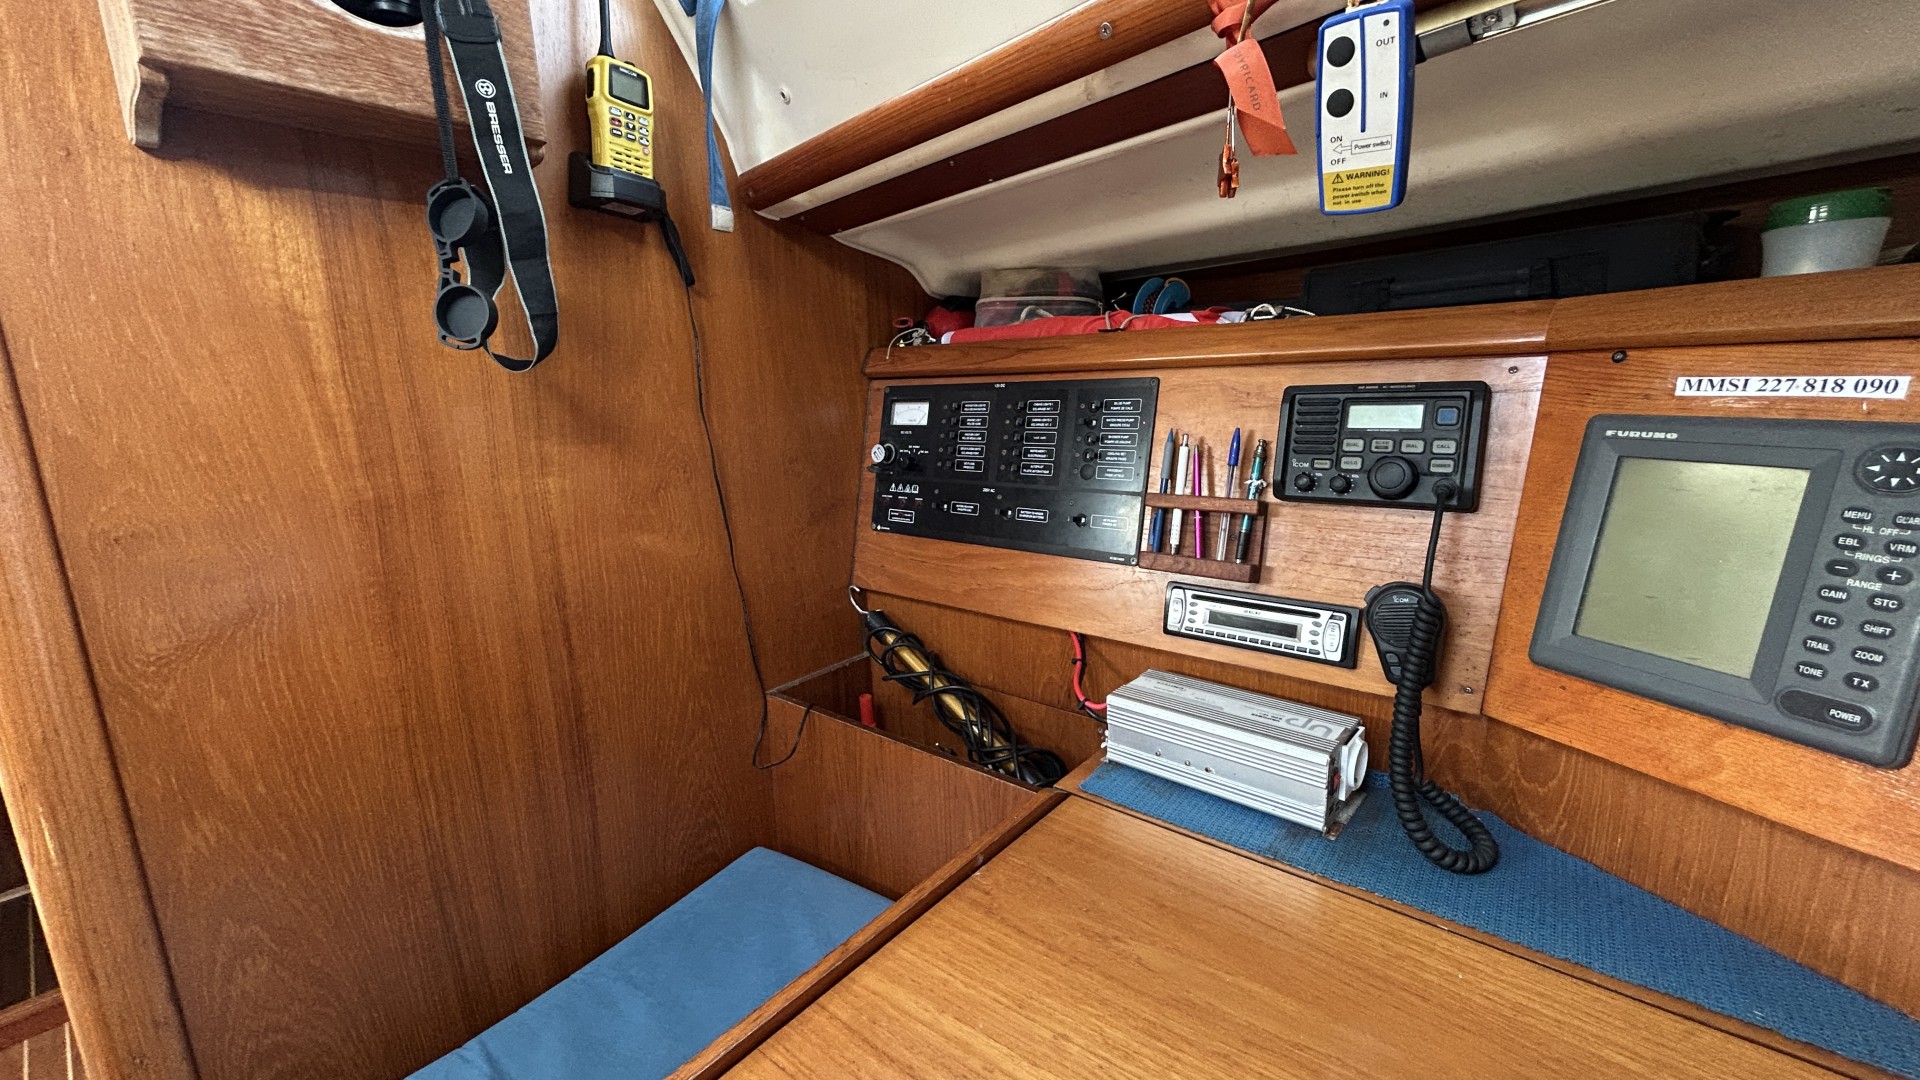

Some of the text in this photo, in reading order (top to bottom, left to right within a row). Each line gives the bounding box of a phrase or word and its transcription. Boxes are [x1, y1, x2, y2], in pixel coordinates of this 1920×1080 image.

[1376, 36, 1396, 47] OUT
[486, 102, 512, 174] BRESSER
[1330, 158, 1346, 166] OFF
[1346, 169, 1390, 180] WARNING!
[1681, 378, 1899, 394] MMSI 227 818 090
[1605, 429, 1678, 440] FURUNO
[1844, 510, 1872, 520] MENU
[1862, 526, 1900, 536] HL OFF
[1838, 537, 1860, 546] EBL
[1890, 543, 1917, 554] VRM
[1855, 552, 1890, 564] RINGS
[1846, 579, 1882, 591] RANGE
[1821, 589, 1848, 600] GAIN
[1874, 598, 1898, 609] STC
[1815, 615, 1836, 626] FTC
[1863, 624, 1892, 636] SHIFT
[1806, 640, 1830, 651] TRAIL
[1855, 651, 1883, 662] ZOOM
[1799, 666, 1823, 678] TONE
[1852, 677, 1870, 688] TX
[1830, 708, 1862, 724] POWER
